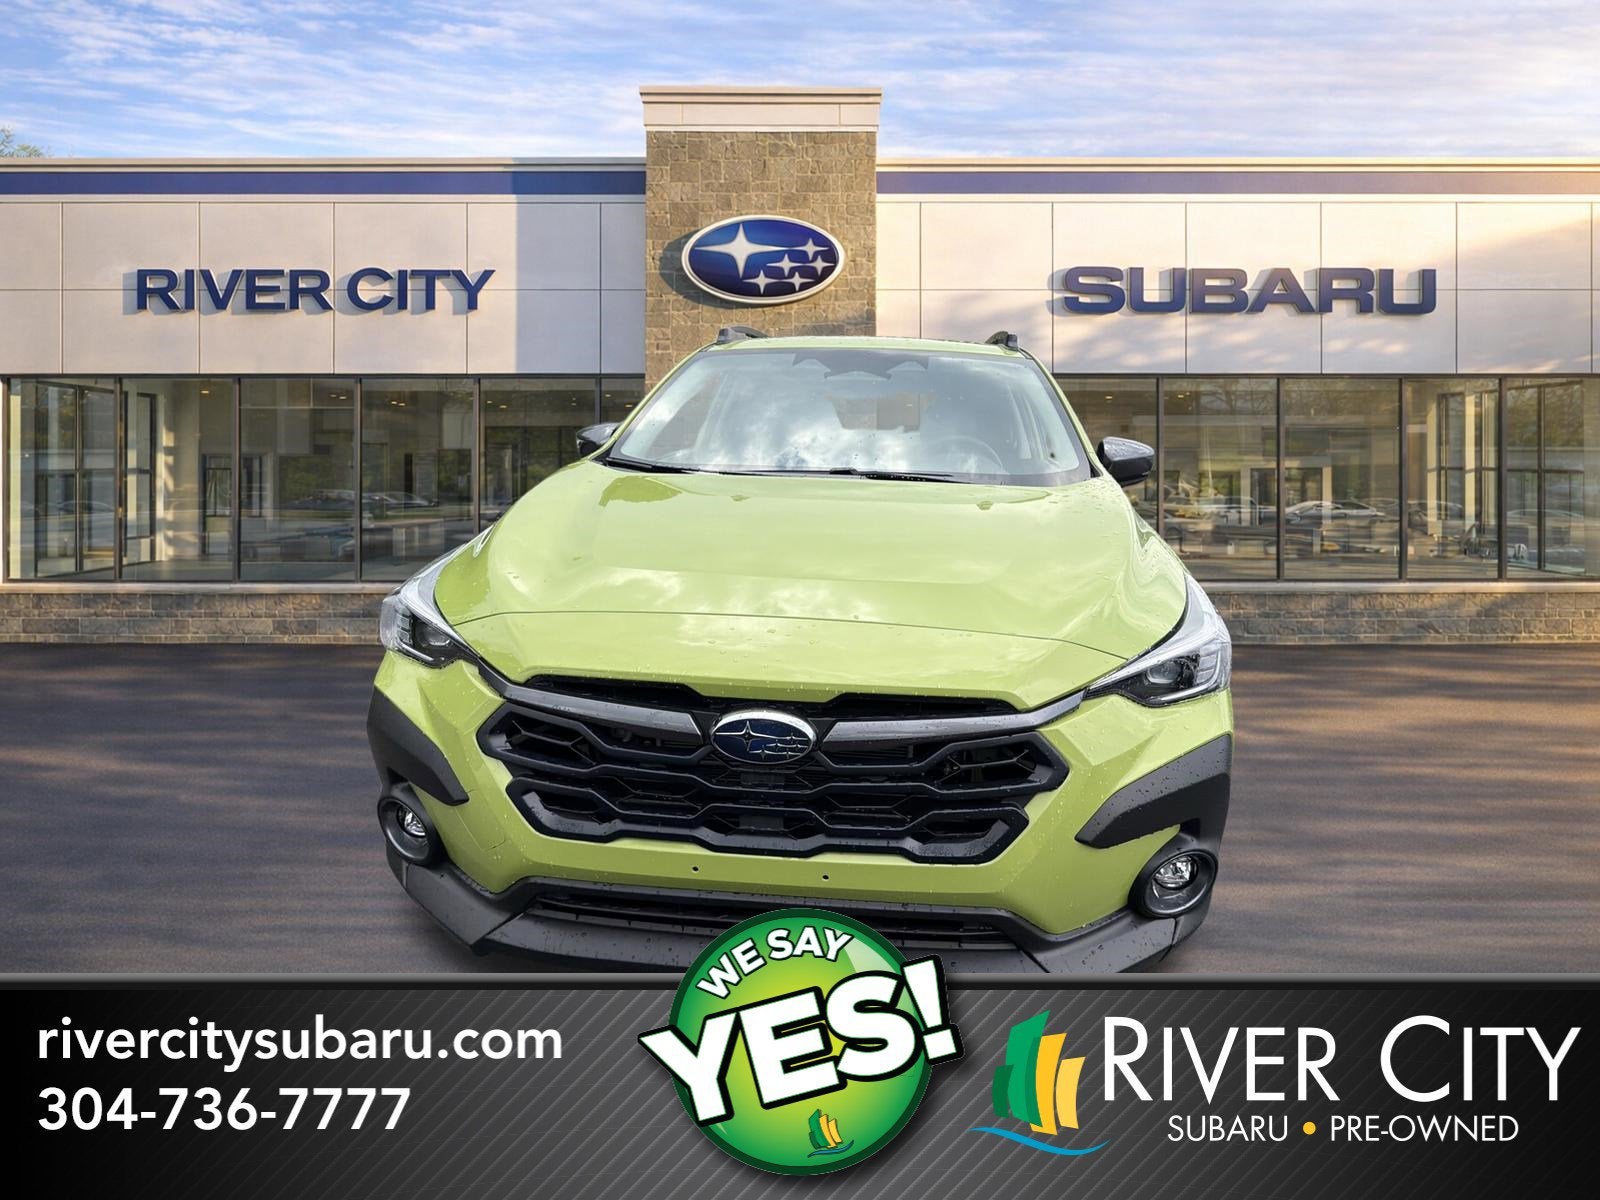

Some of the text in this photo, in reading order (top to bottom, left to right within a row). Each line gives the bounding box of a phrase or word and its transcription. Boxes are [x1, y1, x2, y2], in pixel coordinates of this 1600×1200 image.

[136, 267, 496, 311] RIVER CITY
[1063, 266, 1437, 315] SUBARU
